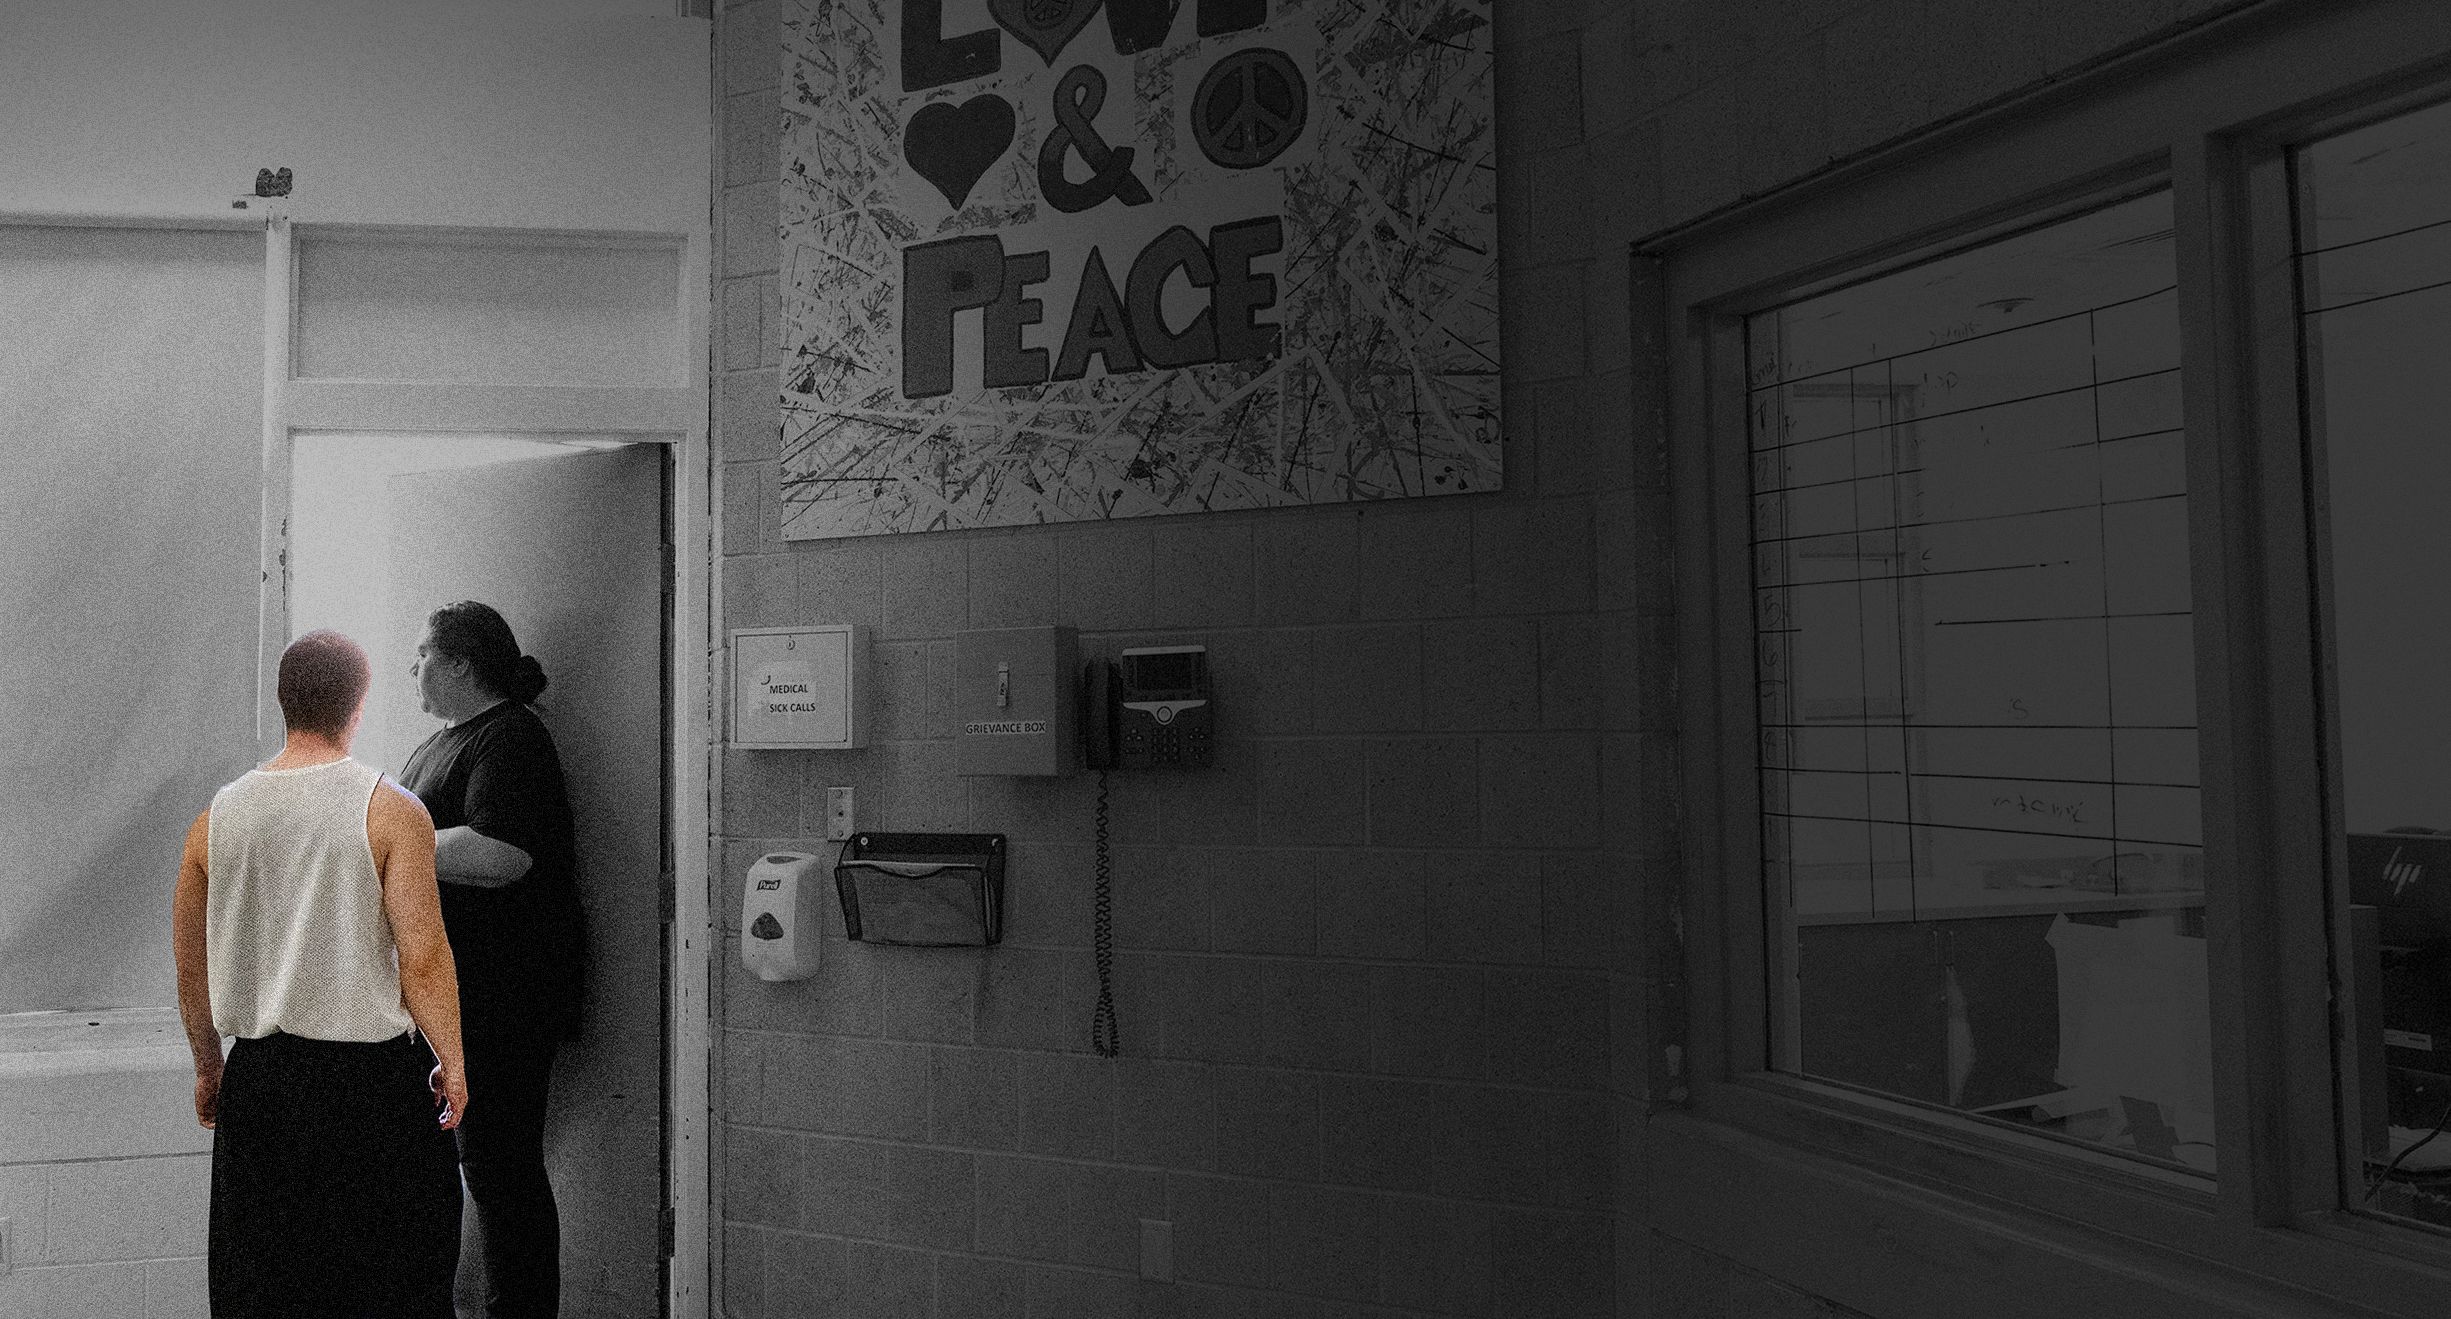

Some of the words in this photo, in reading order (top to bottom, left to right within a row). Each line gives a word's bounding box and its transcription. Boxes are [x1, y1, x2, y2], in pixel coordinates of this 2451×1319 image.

[1037, 64, 1153, 214] &
[902, 215, 1284, 399] PEACE
[769, 684, 809, 694] MEDICAL
[769, 703, 788, 713] SICK
[790, 702, 816, 713] CALLS
[965, 723, 1022, 735] GRIEVANCE
[1024, 722, 1046, 733] BOX
[2382, 846, 2422, 897] hp
